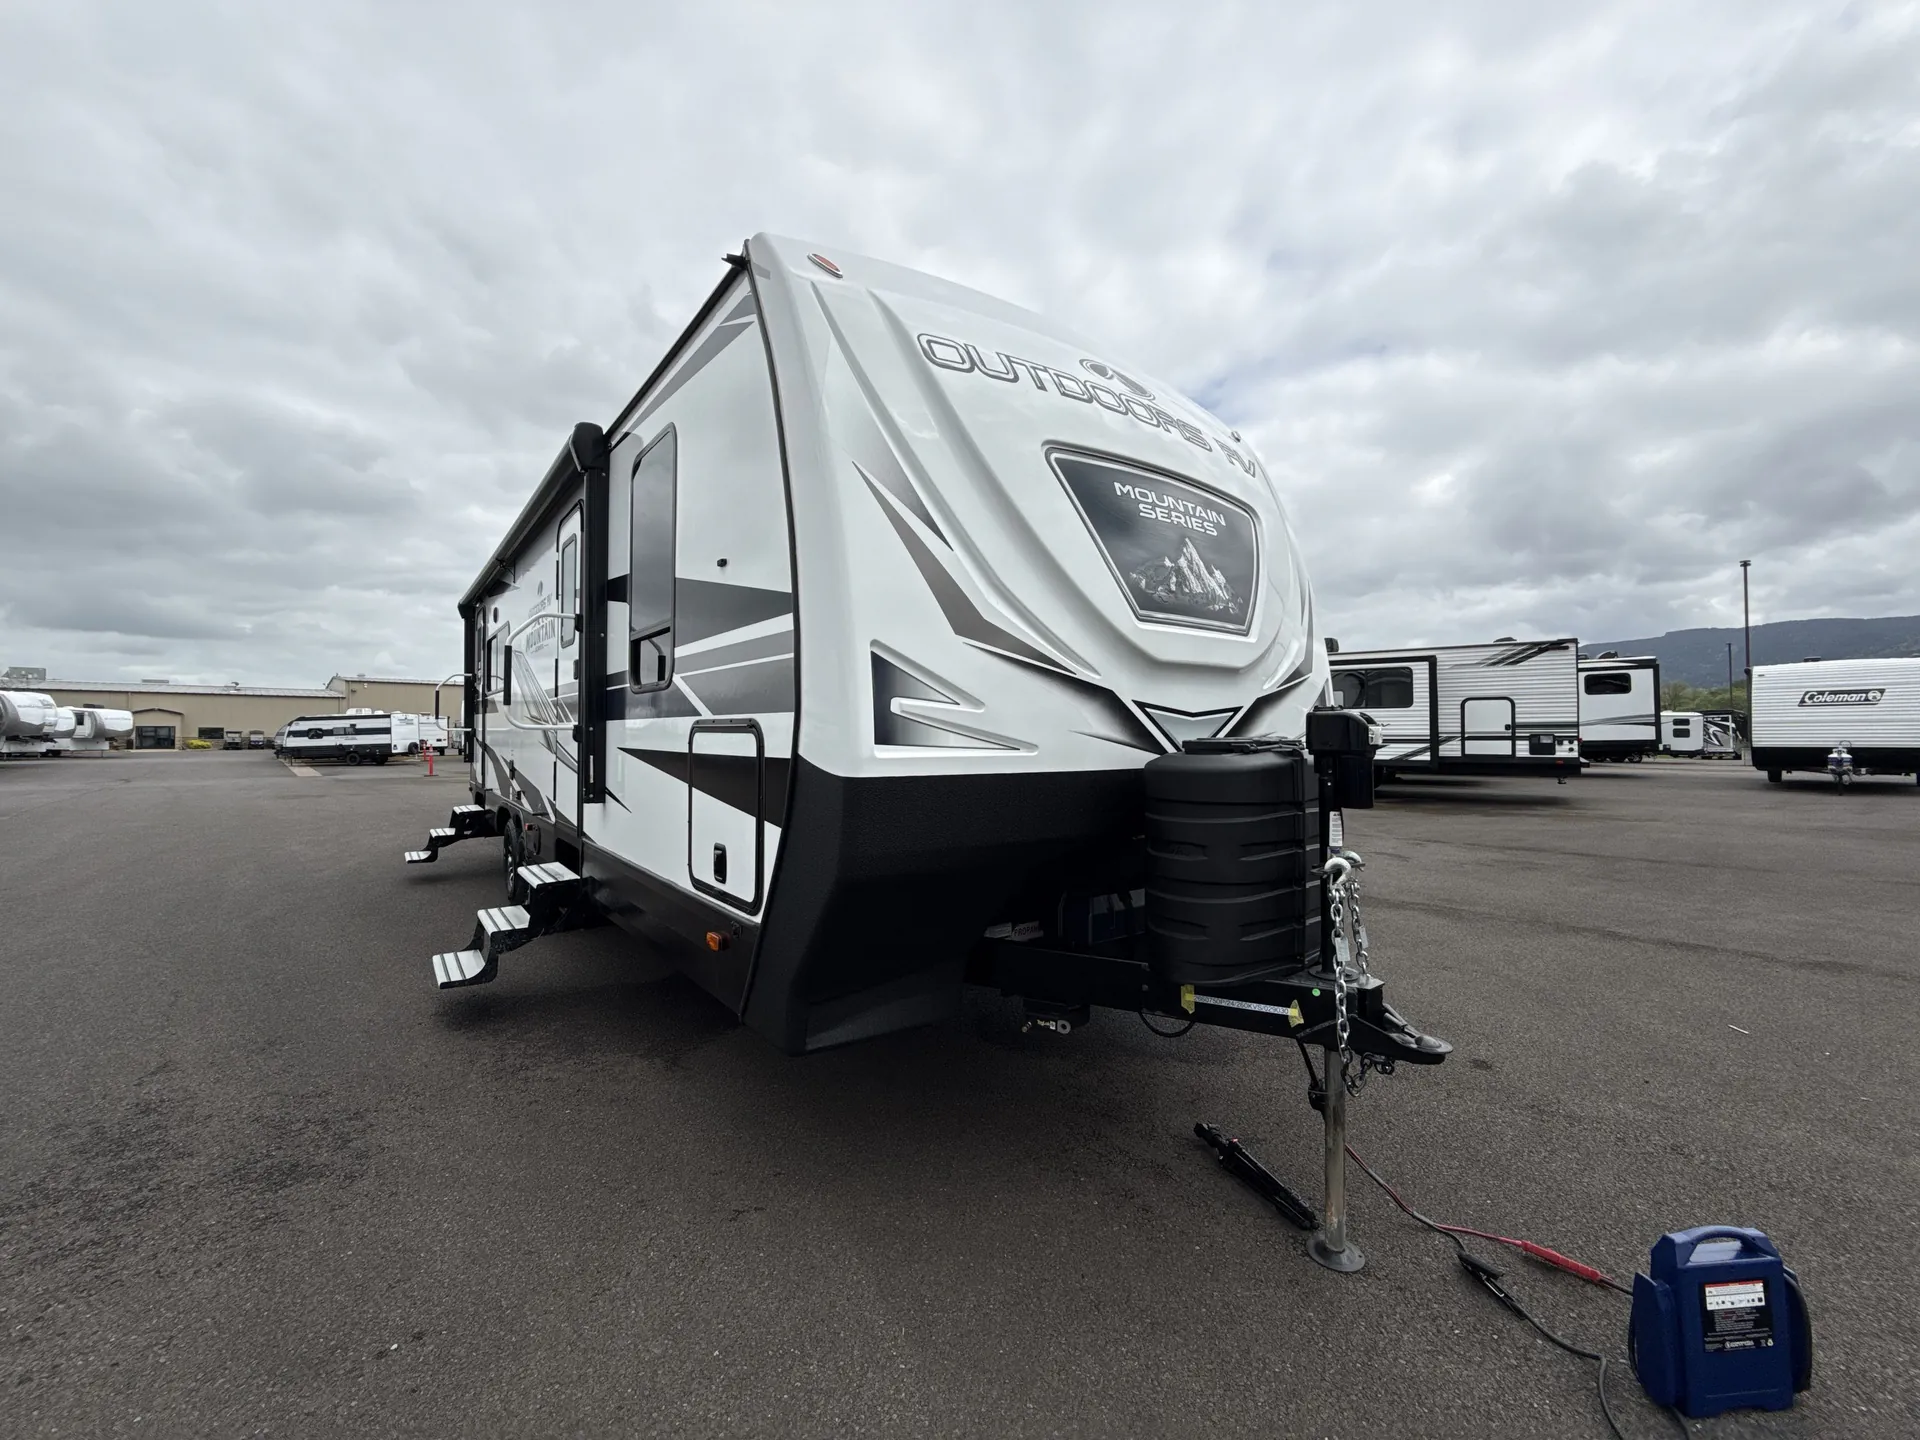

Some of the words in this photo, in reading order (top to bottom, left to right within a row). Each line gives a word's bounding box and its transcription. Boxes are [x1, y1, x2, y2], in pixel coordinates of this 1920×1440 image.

[917, 333, 1213, 452] OUTDOORS
[1212, 437, 1256, 478] RV
[1113, 481, 1226, 526] MOUNTAIN
[1138, 503, 1218, 536] SERIES
[526, 618, 556, 653] MOUNTAIN
[1804, 691, 1866, 703] Coleman
[1014, 925, 1038, 937] PROPAN
